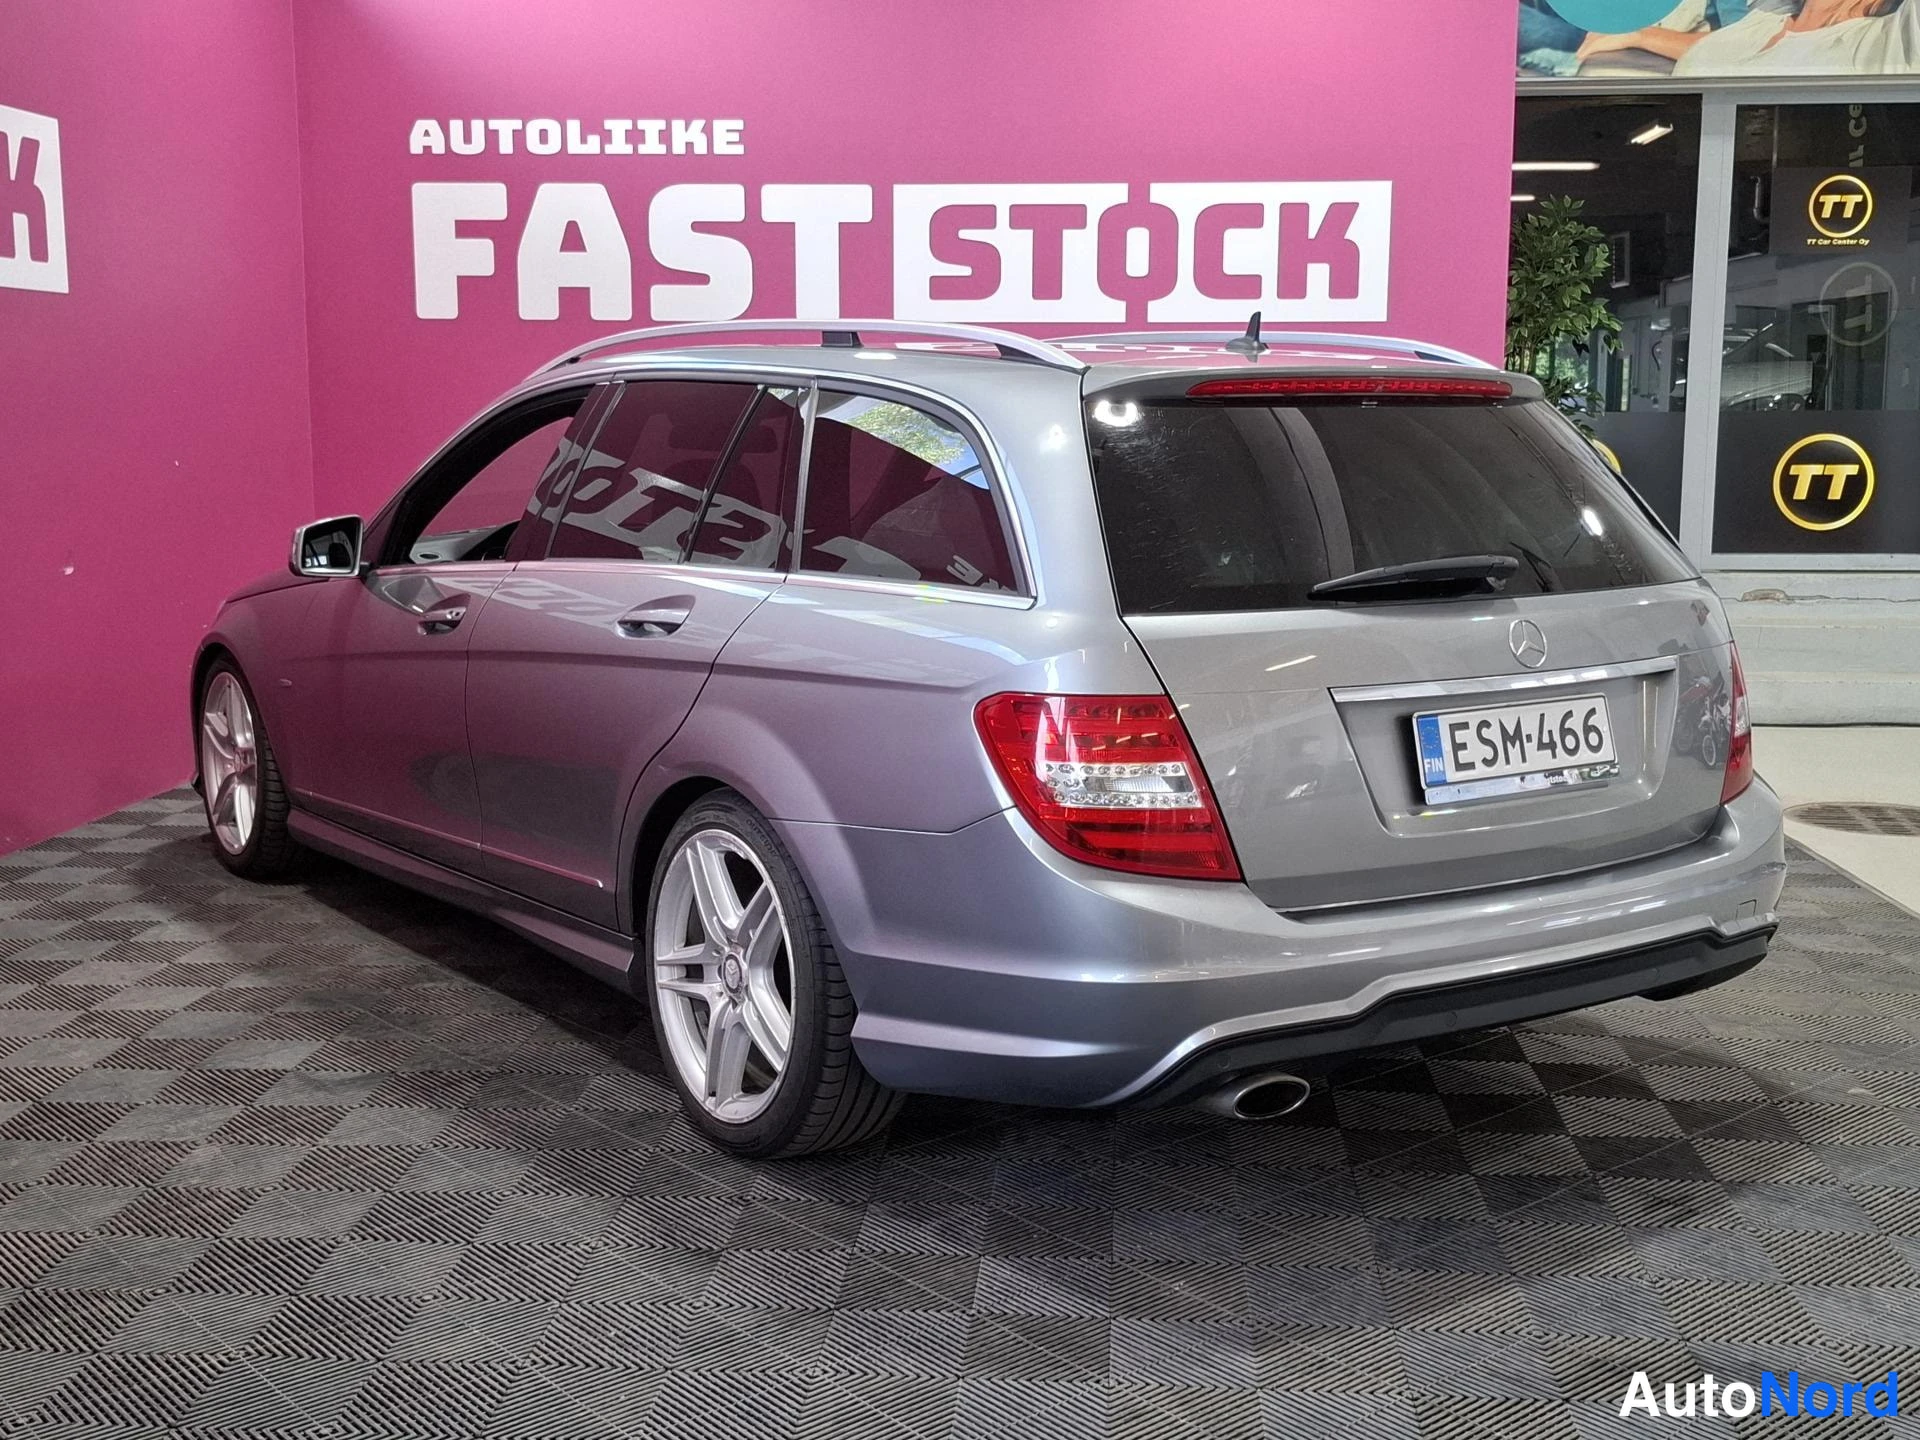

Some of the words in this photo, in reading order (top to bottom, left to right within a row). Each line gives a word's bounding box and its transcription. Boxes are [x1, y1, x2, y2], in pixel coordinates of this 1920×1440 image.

[409, 118, 744, 155] AUTOLIIKE
[1819, 194, 1863, 219] TT
[411, 182, 873, 321] FAST
[929, 202, 1360, 301] STOCK
[1858, 238, 1870, 246] Oy
[1789, 463, 1860, 500] TT
[1449, 706, 1604, 772] ESM-466
[1424, 757, 1444, 773] FIN
